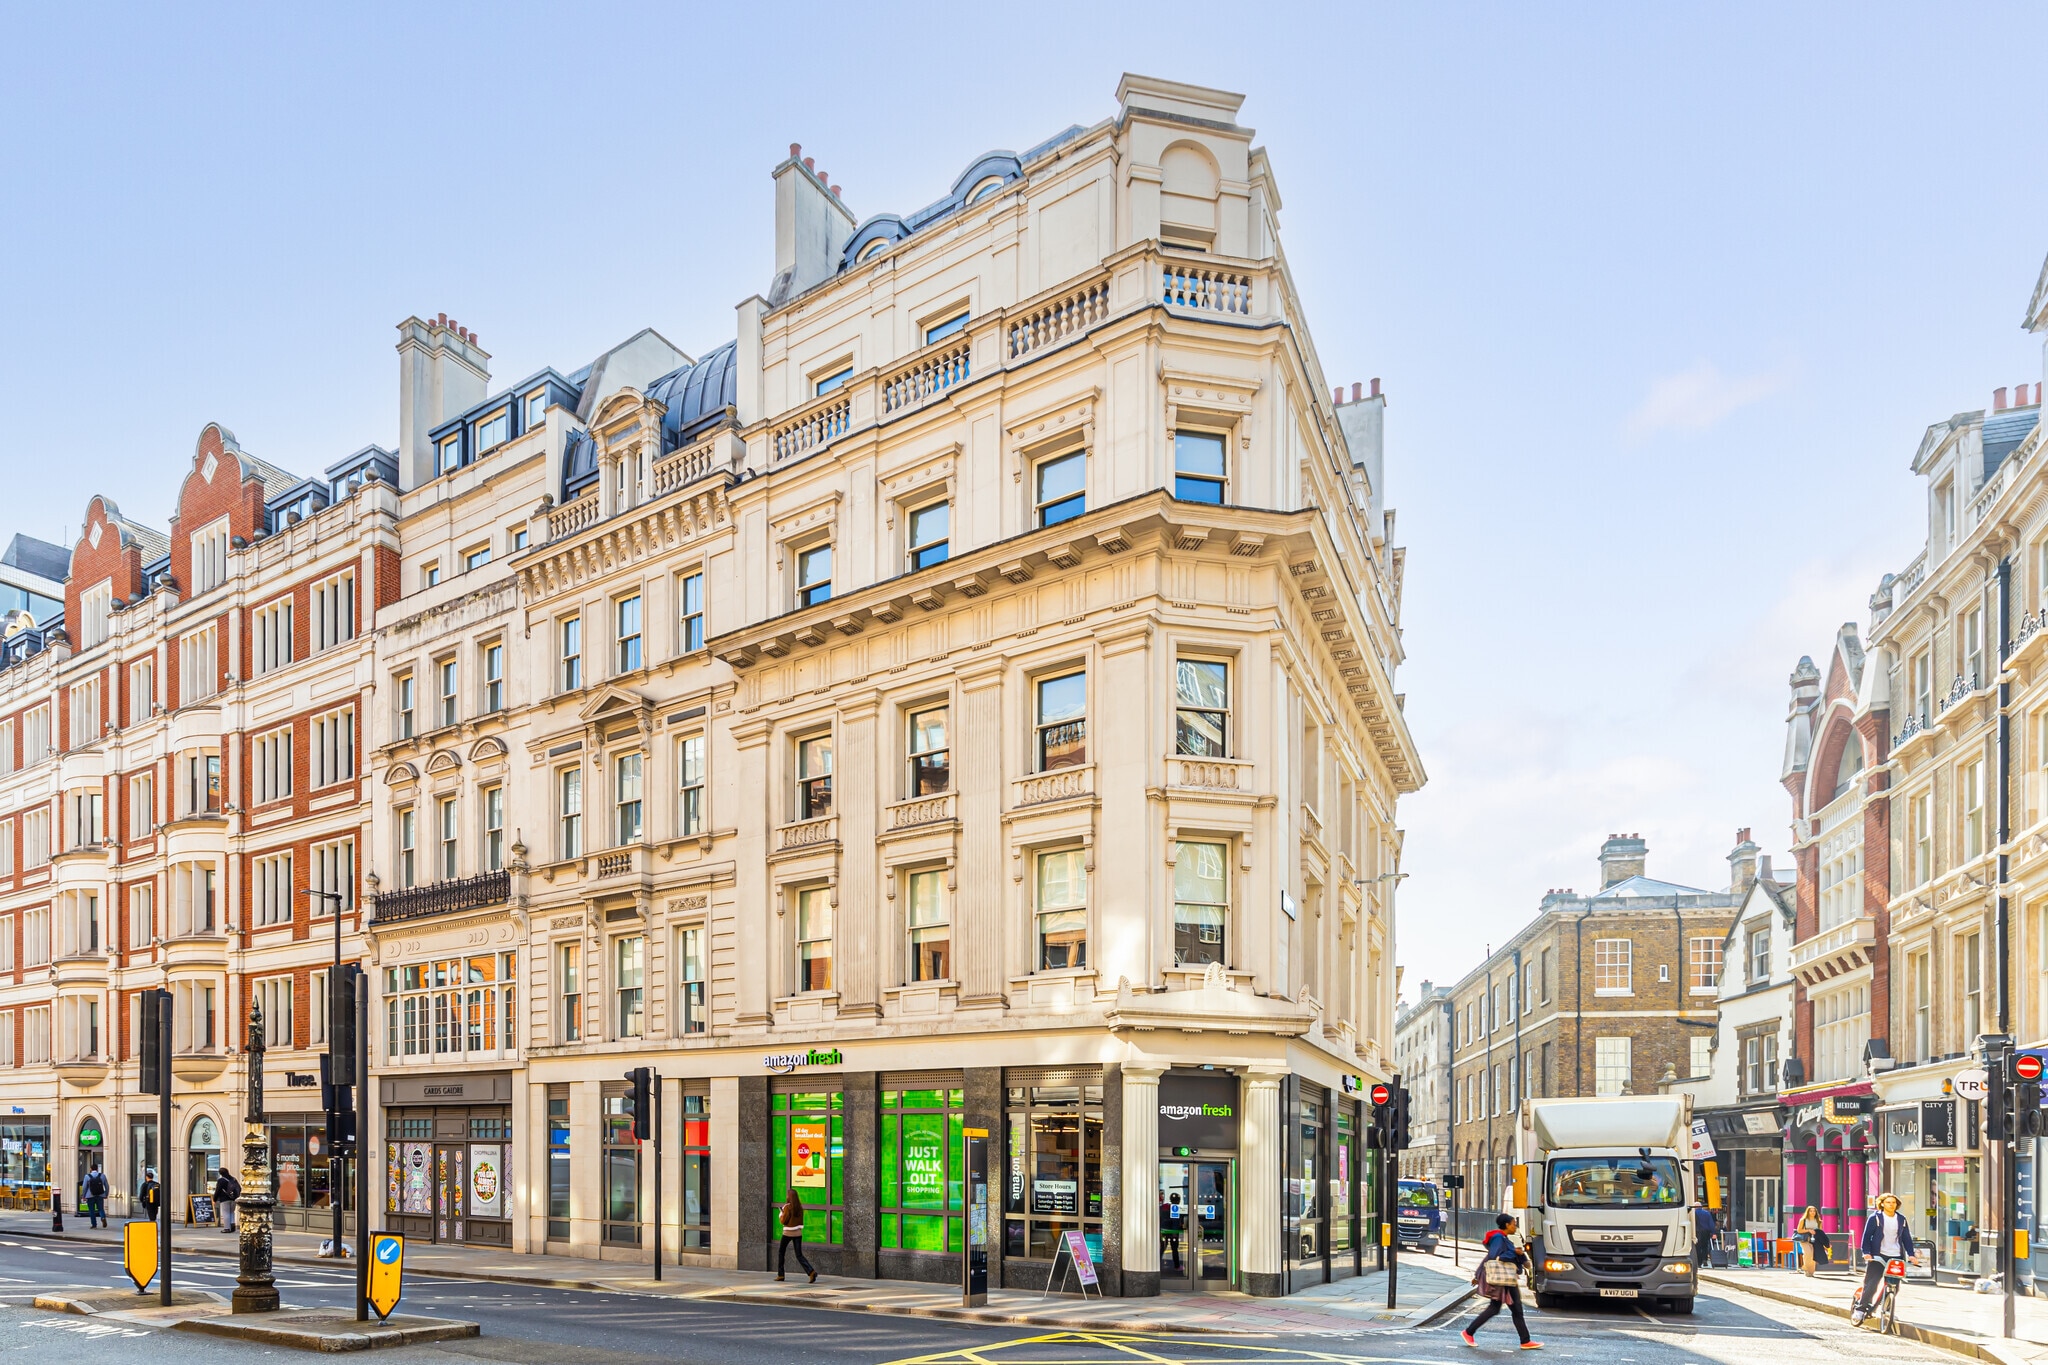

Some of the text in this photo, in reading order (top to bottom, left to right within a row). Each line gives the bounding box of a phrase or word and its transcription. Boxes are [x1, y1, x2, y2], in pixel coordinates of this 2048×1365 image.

[424, 1086, 464, 1095] CARDS GALORE
[1891, 1121, 1906, 1137] City
[281, 1154, 299, 1162] months
[908, 1146, 939, 1158] JUST
[905, 1160, 942, 1172] WALK
[910, 1173, 937, 1185] OUT
[906, 1186, 940, 1194] SHOPPING
